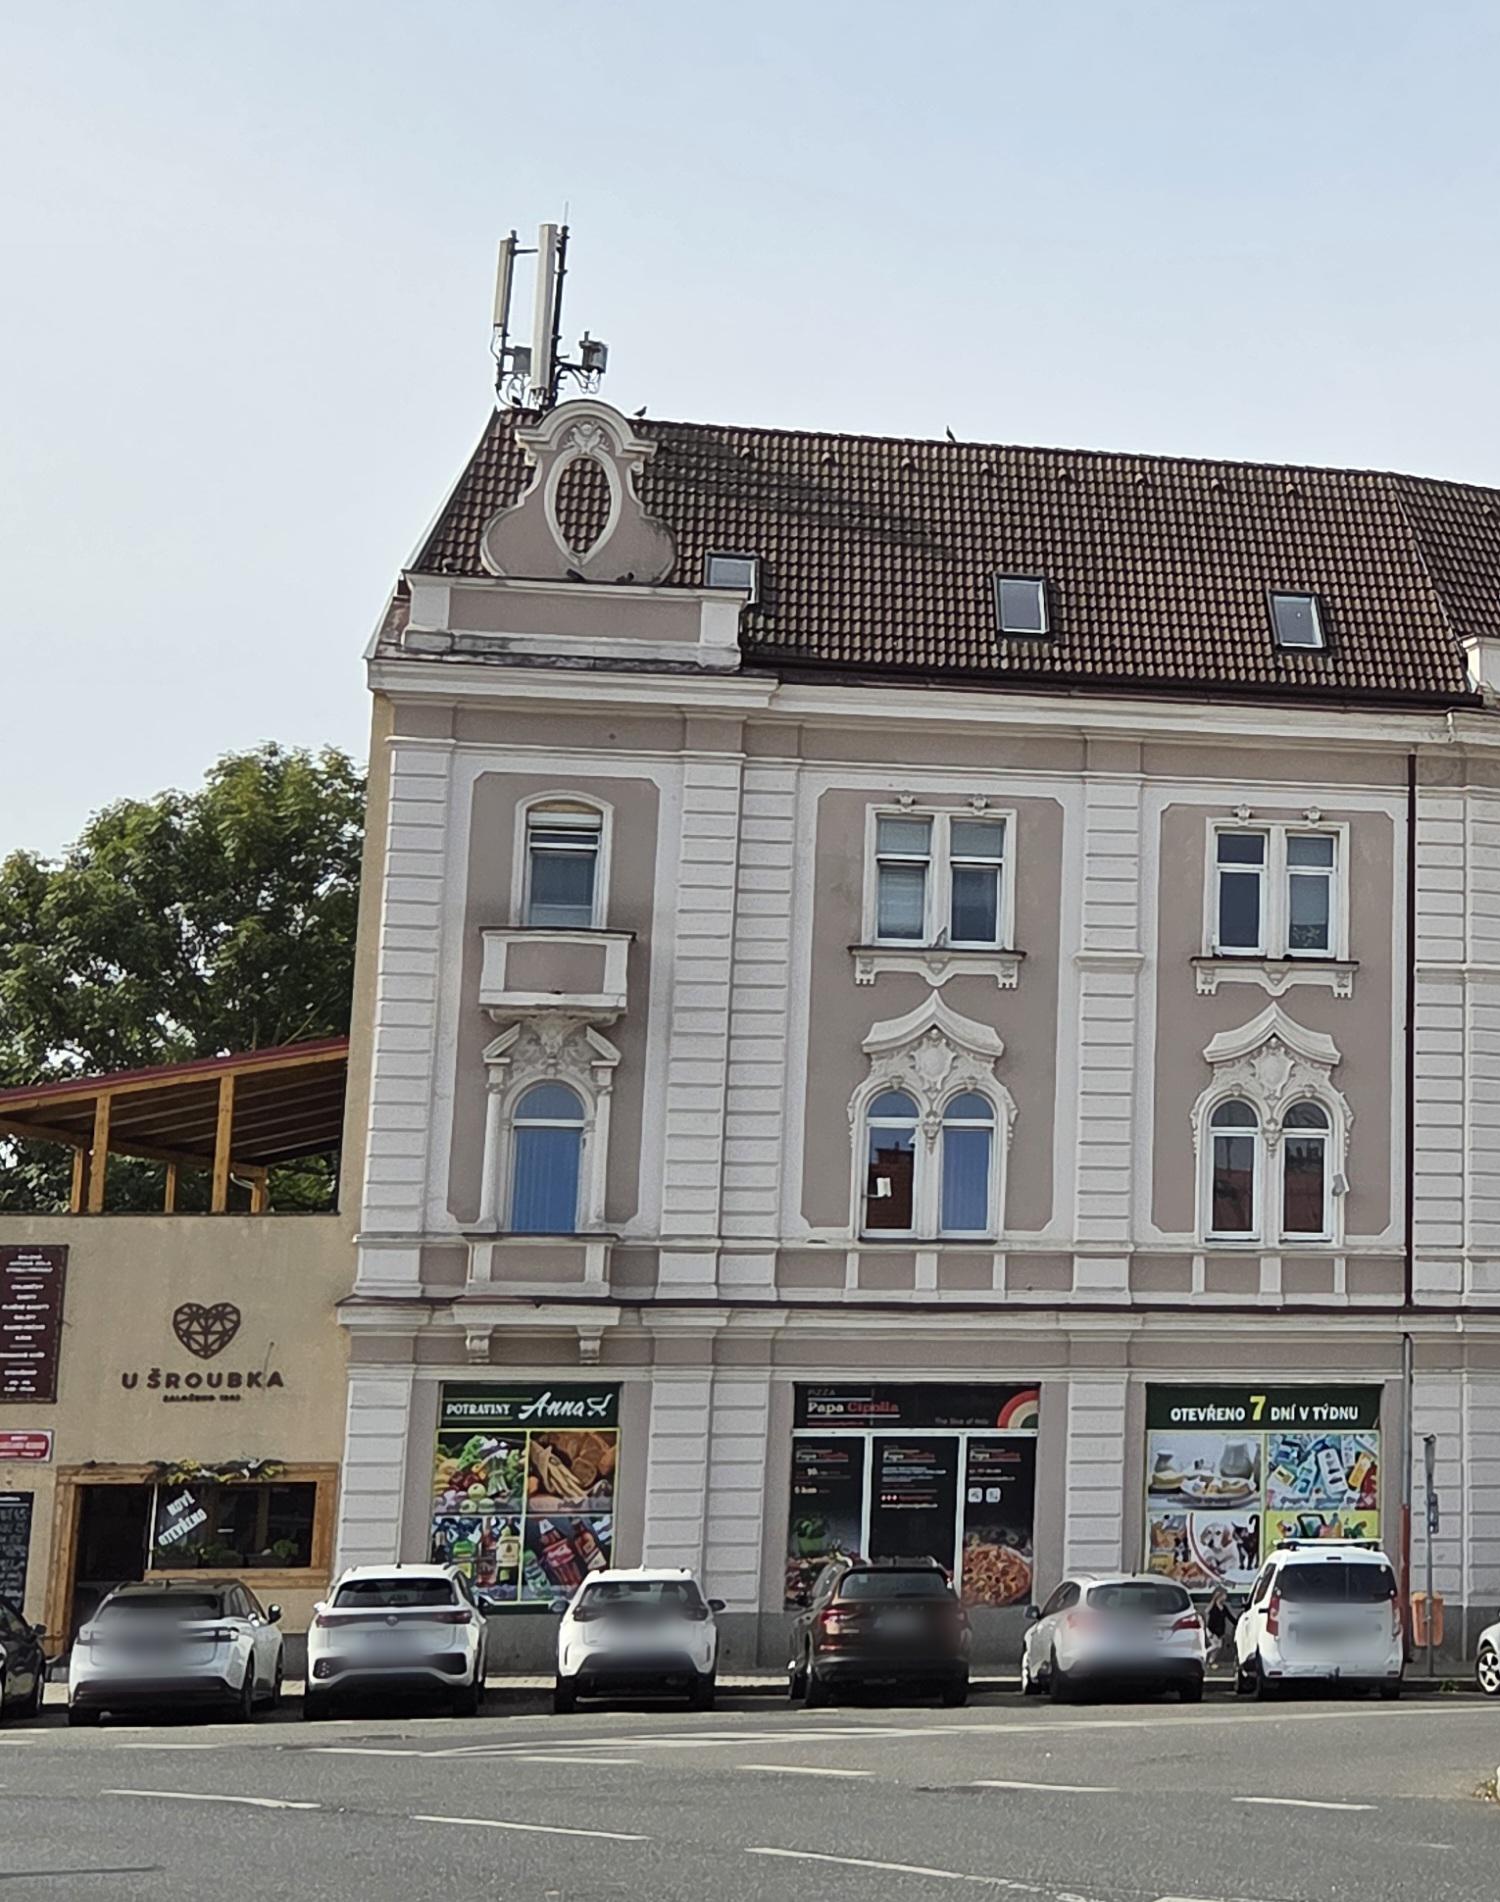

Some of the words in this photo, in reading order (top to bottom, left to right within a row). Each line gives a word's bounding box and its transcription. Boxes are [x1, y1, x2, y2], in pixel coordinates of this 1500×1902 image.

[122, 1372, 138, 1389] U
[146, 1367, 284, 1389] ŠROUBKA
[446, 1403, 512, 1416] POTRAVINY
[518, 1391, 584, 1421] Anna
[807, 1402, 844, 1416] Papa
[1170, 1403, 1246, 1421] OTEVŘENO
[1250, 1395, 1266, 1421] 7
[1271, 1403, 1296, 1421] DNÍ
[1299, 1407, 1309, 1421] V
[1312, 1402, 1359, 1421] TÝDNU
